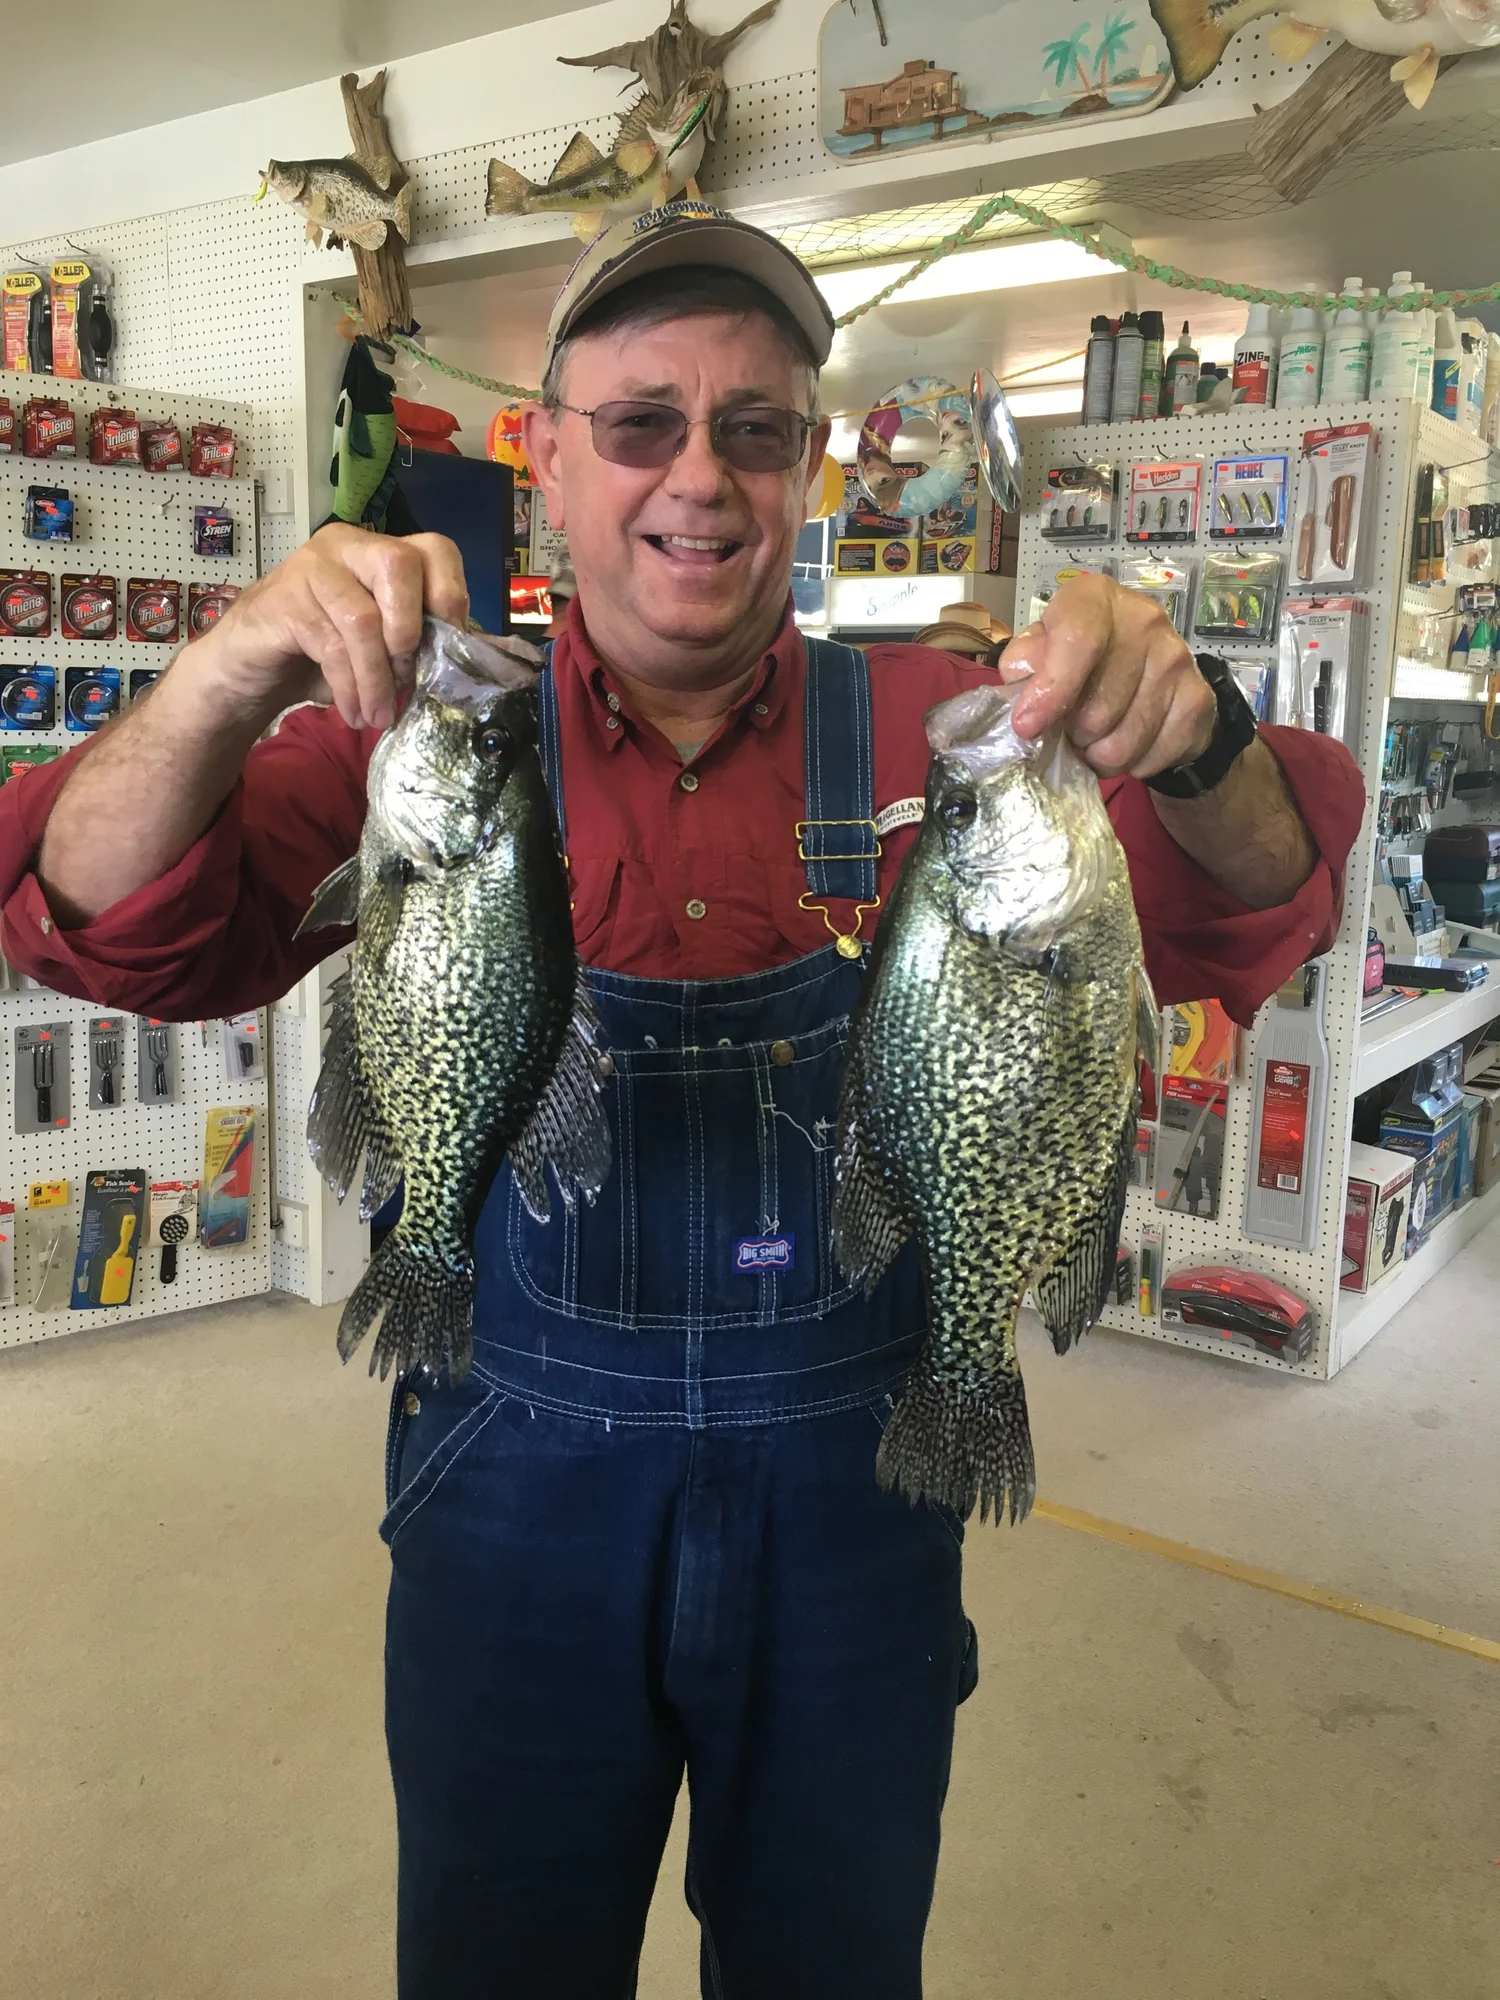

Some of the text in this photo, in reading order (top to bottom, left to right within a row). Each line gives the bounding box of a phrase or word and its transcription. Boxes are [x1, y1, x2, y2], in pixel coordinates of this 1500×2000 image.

[1237, 351, 1264, 366] ZING
[149, 439, 179, 461] Trilee
[202, 446, 233, 460] Trilee
[1154, 471, 1179, 484] Heddon
[1235, 463, 1264, 479] REBEL
[203, 524, 232, 536] STREN
[990, 503, 1002, 571] RHEAD
[866, 582, 918, 616] Spple
[742, 1244, 785, 1260] BIG SMITH
